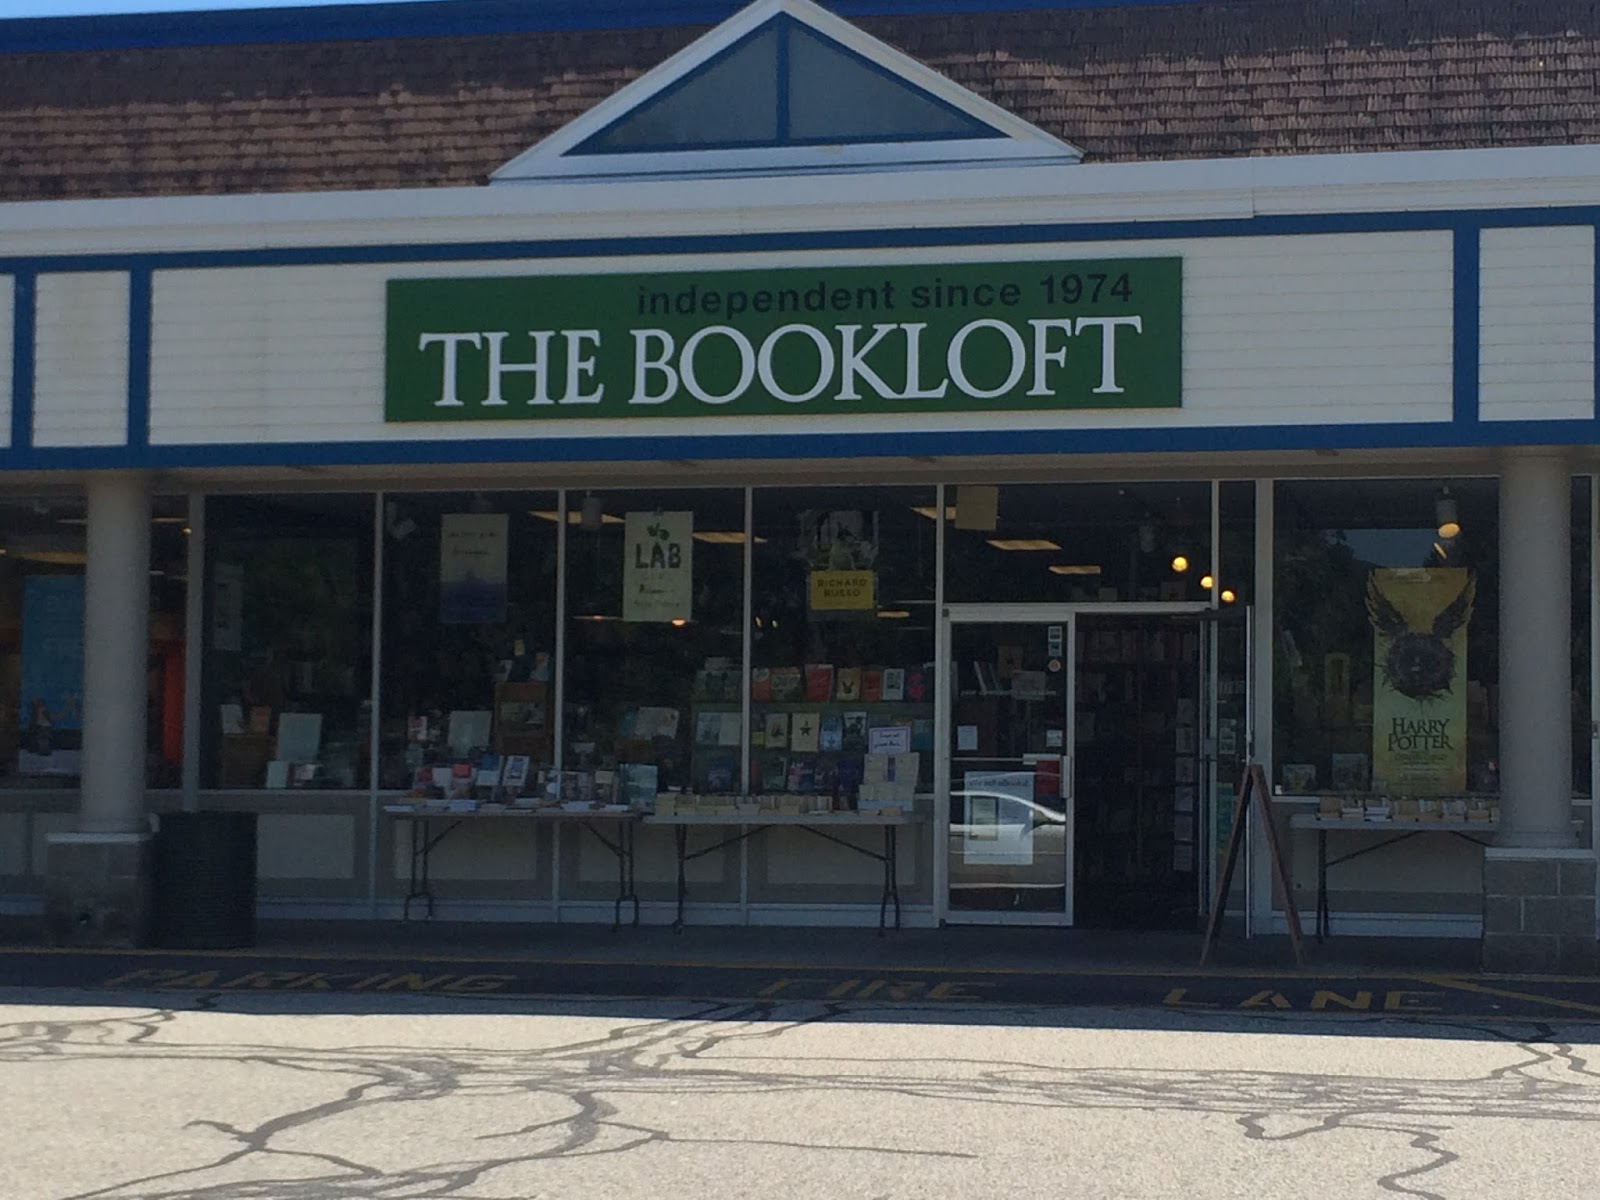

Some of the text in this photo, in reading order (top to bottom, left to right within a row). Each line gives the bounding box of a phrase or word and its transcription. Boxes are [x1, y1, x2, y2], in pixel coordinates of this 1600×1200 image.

[638, 272, 1132, 318] independent since 1974
[419, 315, 1142, 407] THE BOOKLOFT
[634, 541, 682, 569] LAB
[817, 578, 869, 589] RICHARD
[1392, 717, 1450, 735] HARRY
[1388, 733, 1455, 752] POTTER
[104, 969, 1447, 1010] PARKING FIRE LANE
